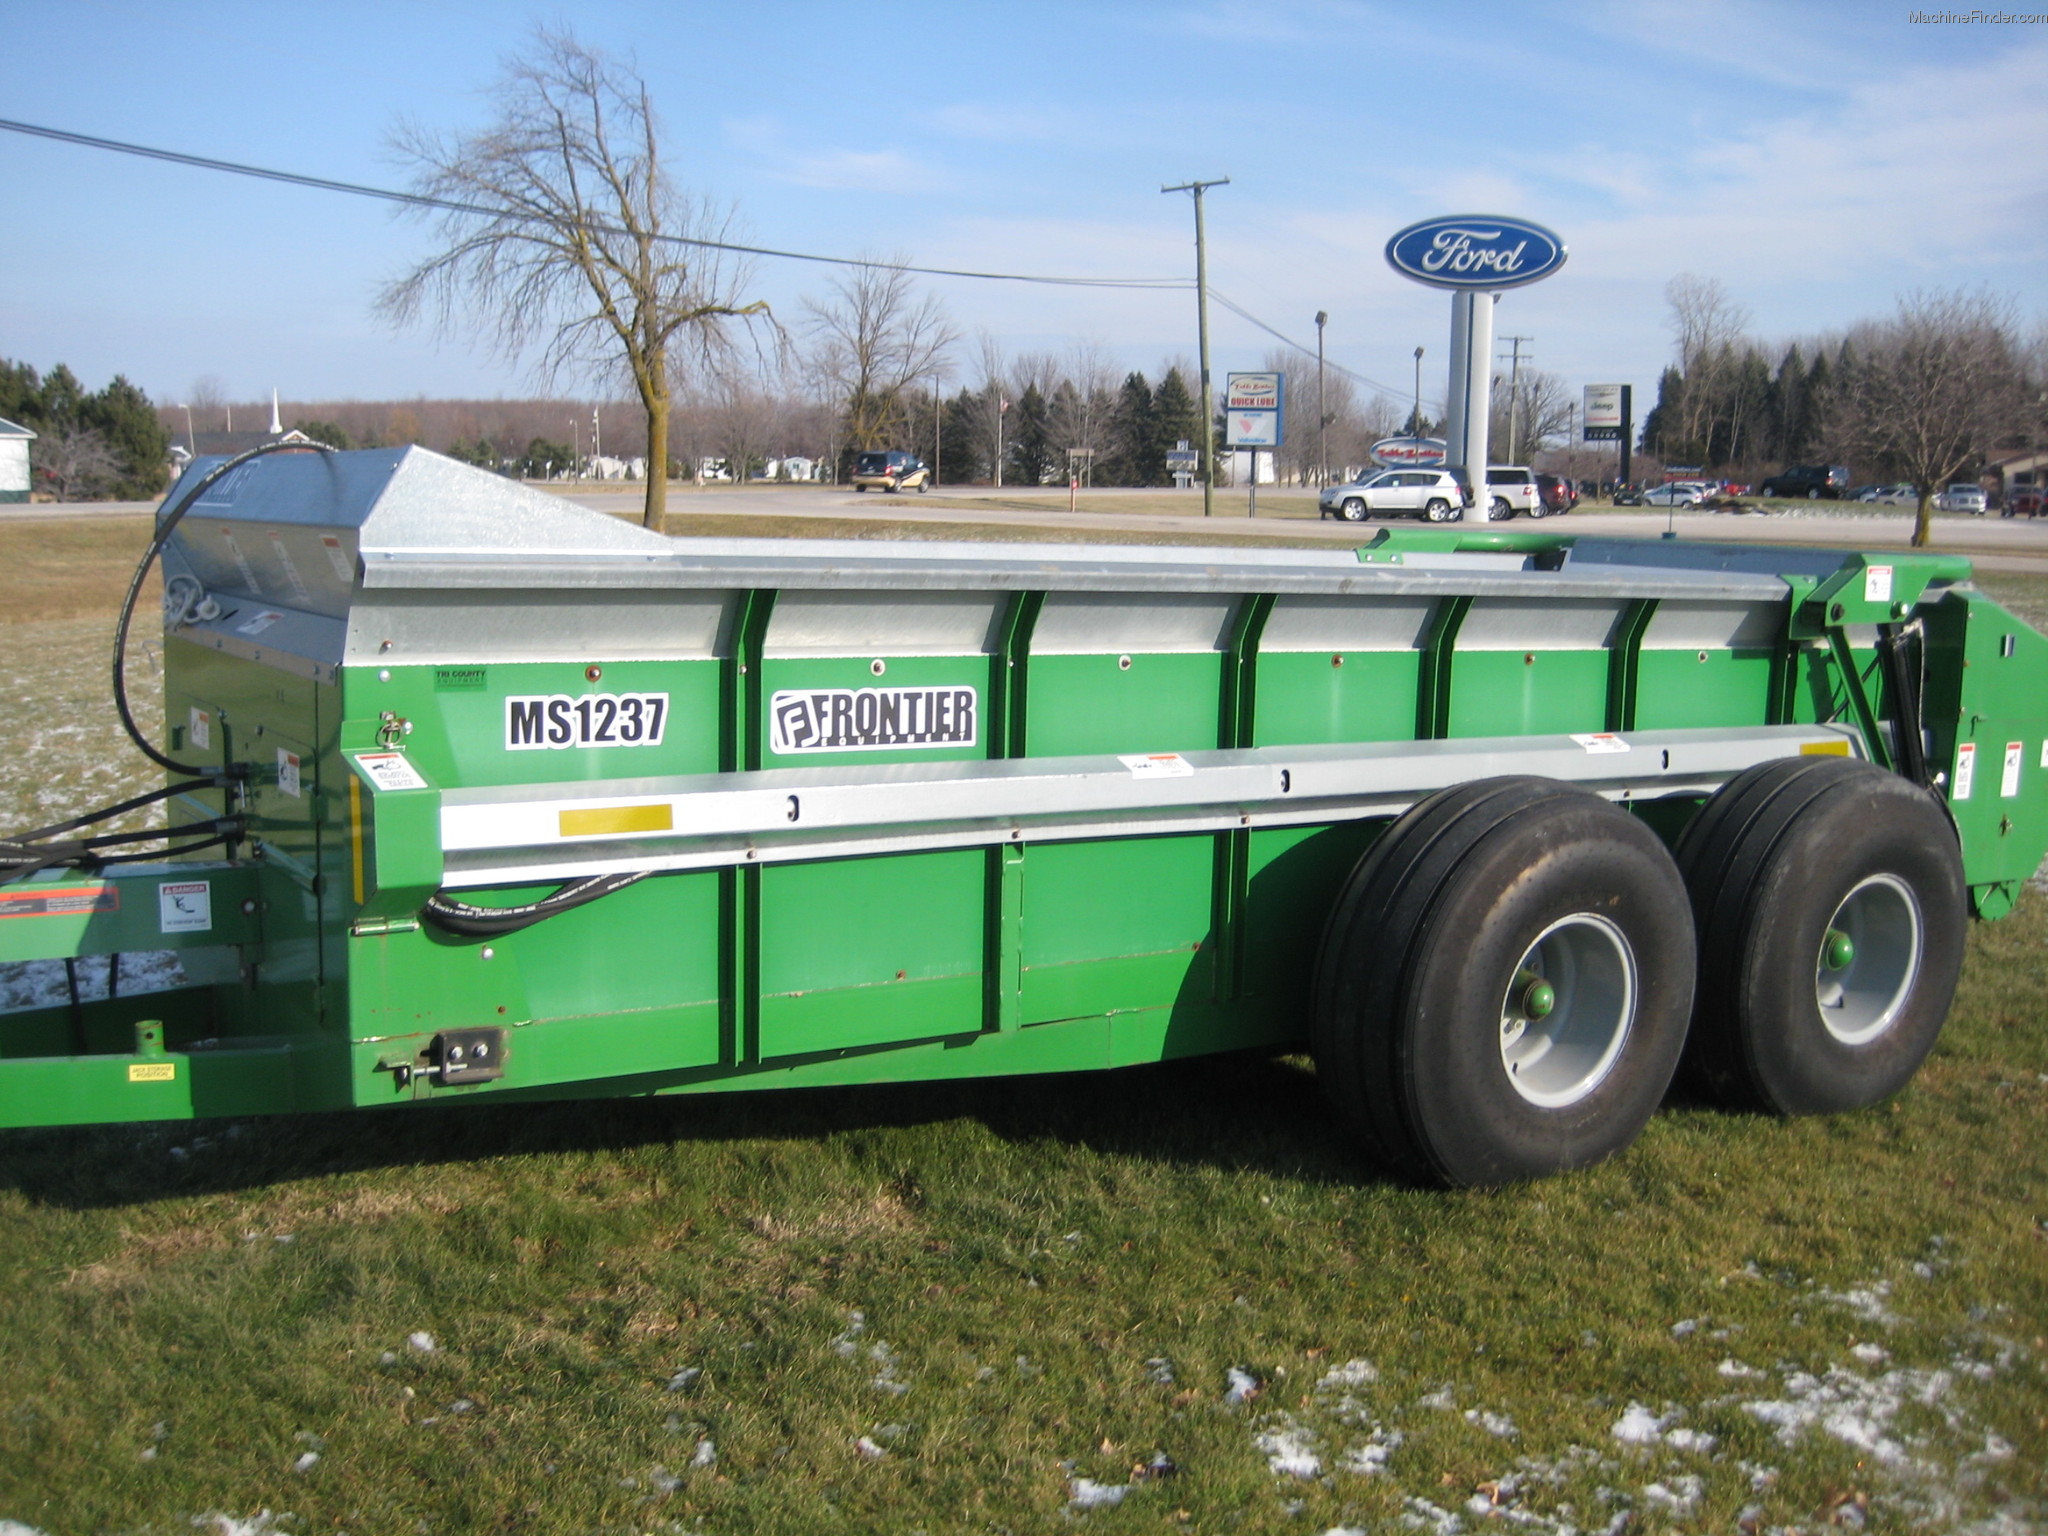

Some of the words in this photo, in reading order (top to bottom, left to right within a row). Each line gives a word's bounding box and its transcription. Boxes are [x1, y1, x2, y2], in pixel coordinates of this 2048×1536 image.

[1421, 229, 1528, 272] Ford
[1231, 397, 1255, 406] QUICK
[1256, 397, 1275, 406] LUBE
[452, 670, 486, 678] COUNTY
[510, 698, 664, 745] MS1237
[811, 691, 973, 746] FRONTIER
[821, 732, 966, 747] EQUIPMENT
[172, 884, 205, 894] DANGER
